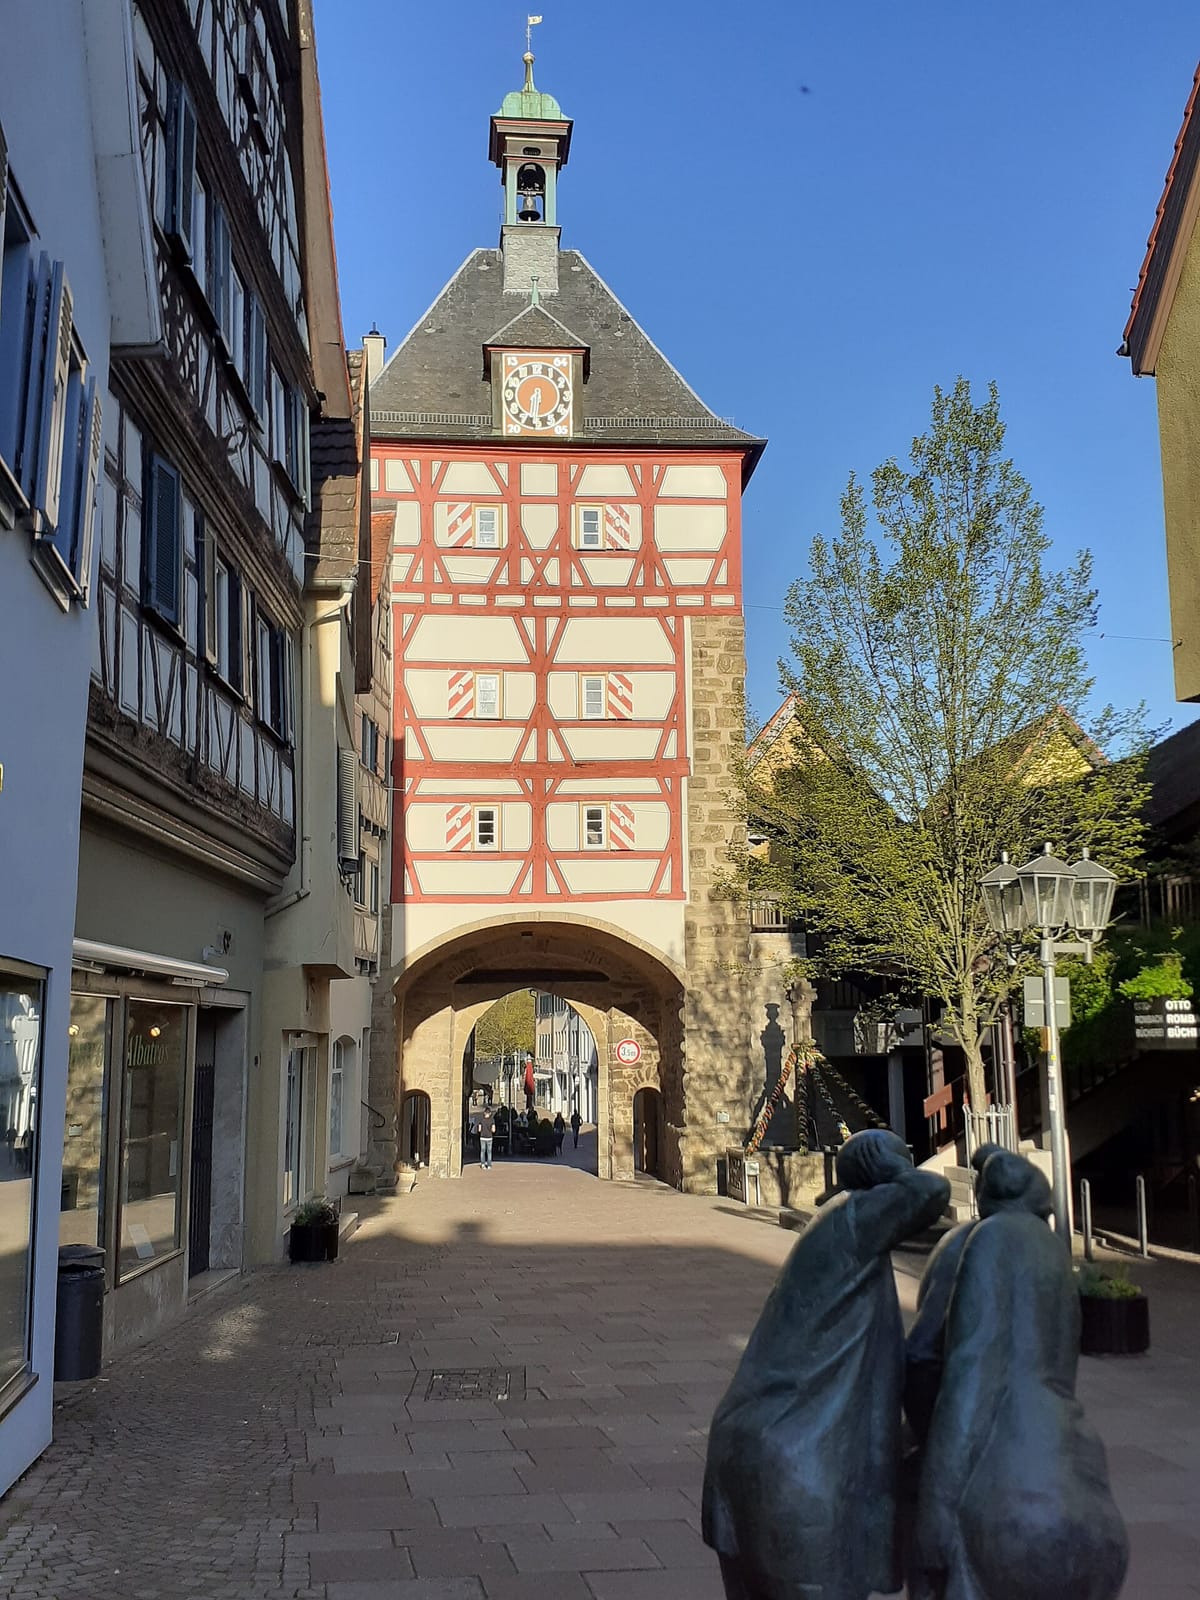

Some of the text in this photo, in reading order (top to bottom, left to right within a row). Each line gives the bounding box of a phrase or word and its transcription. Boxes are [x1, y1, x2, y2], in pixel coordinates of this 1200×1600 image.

[507, 357, 518, 366] 15
[519, 366, 528, 378] 11
[532, 364, 542, 374] 12
[508, 377, 520, 388] 10
[558, 377, 565, 388] 2
[505, 389, 514, 400] 9
[562, 390, 571, 402] 3
[510, 402, 518, 414] 8
[558, 404, 568, 416] 4
[546, 414, 555, 426] 5
[507, 424, 520, 433] 20
[1165, 1000, 1192, 1010] OTTO
[127, 1034, 168, 1066] Albatros
